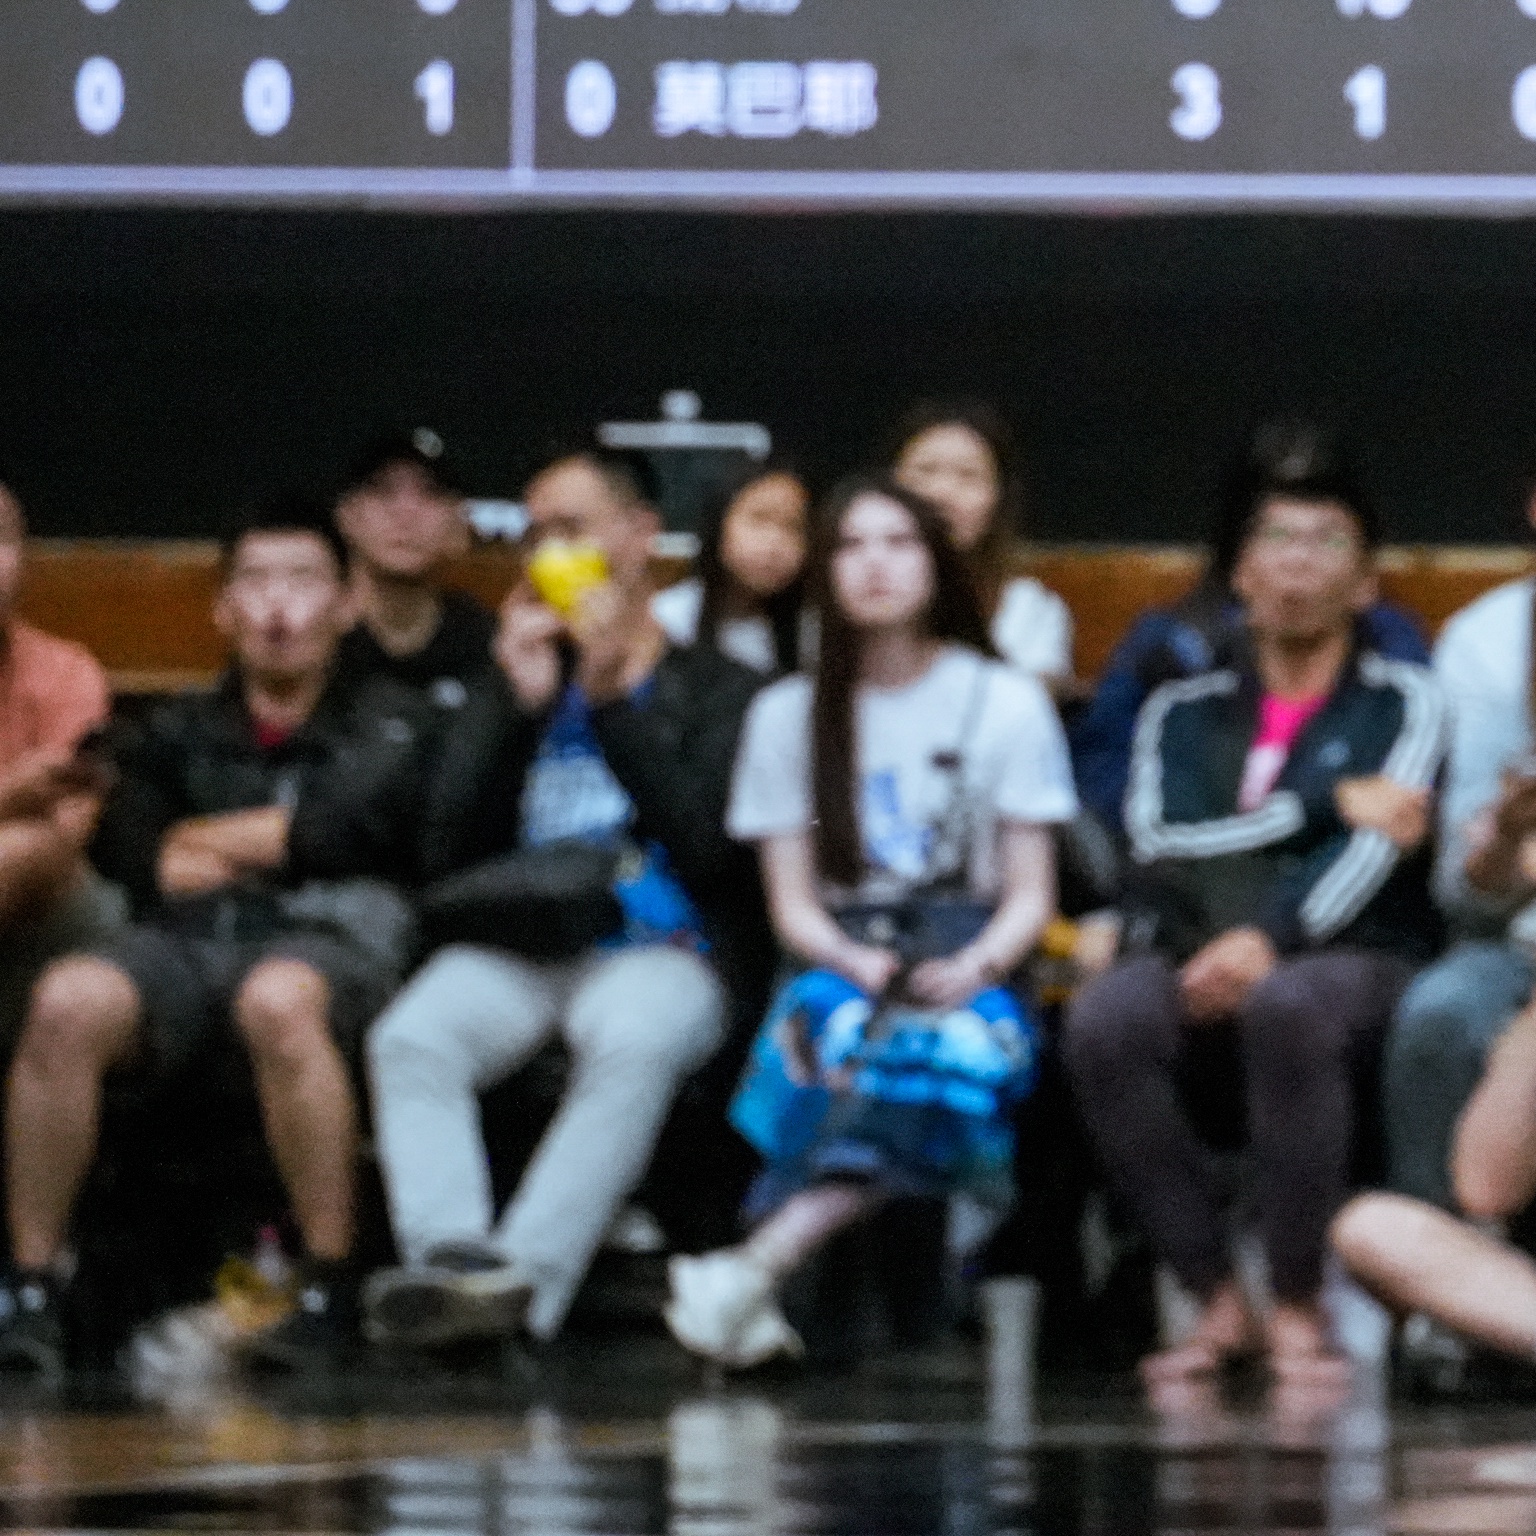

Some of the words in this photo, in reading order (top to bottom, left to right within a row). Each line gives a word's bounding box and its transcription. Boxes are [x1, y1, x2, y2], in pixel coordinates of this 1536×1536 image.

[73, 55, 126, 137] 0
[240, 56, 293, 138] 0
[414, 57, 455, 137] 1
[563, 58, 618, 140] 0
[1168, 60, 1224, 143] 3
[1341, 62, 1389, 142] 1
